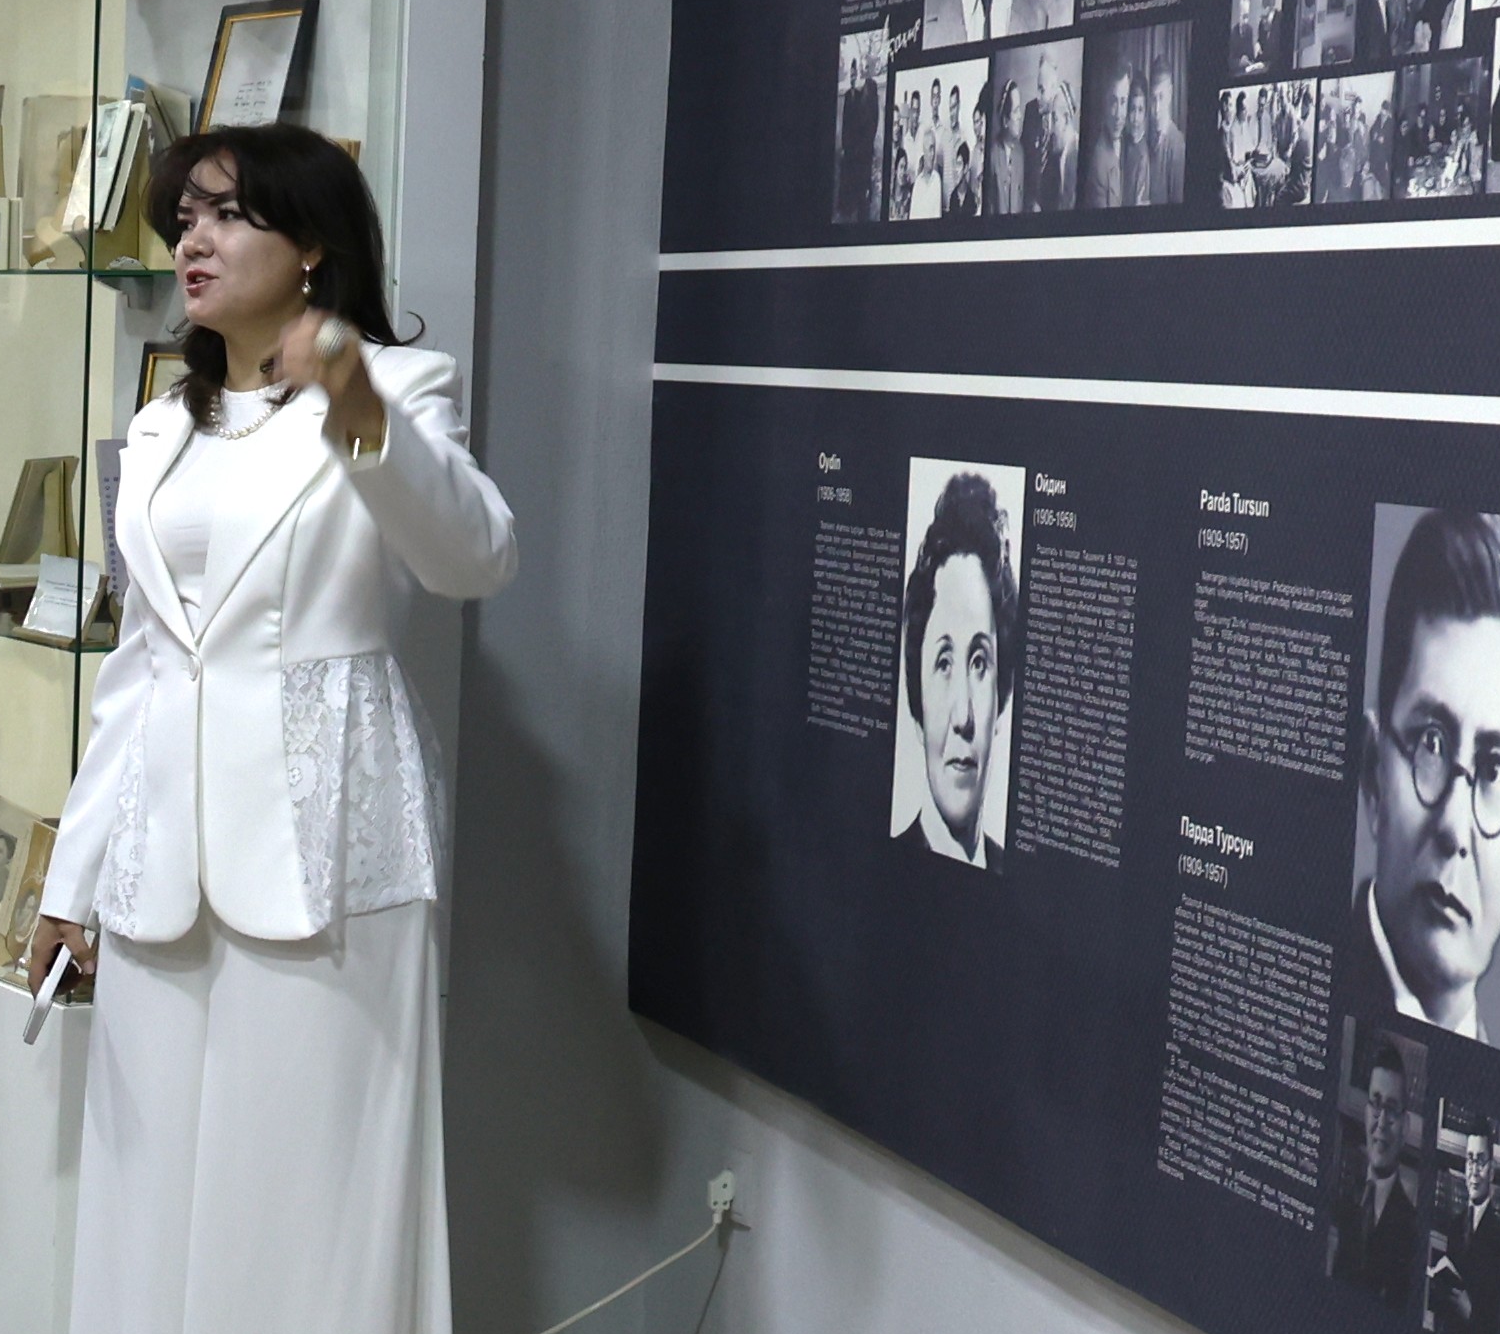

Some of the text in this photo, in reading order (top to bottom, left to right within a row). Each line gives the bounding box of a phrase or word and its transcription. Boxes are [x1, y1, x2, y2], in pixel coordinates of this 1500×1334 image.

[1035, 472, 1067, 497] Ойдин
[1200, 489, 1270, 518] Parda Tursun
[1180, 815, 1255, 860] Парда Турсун
